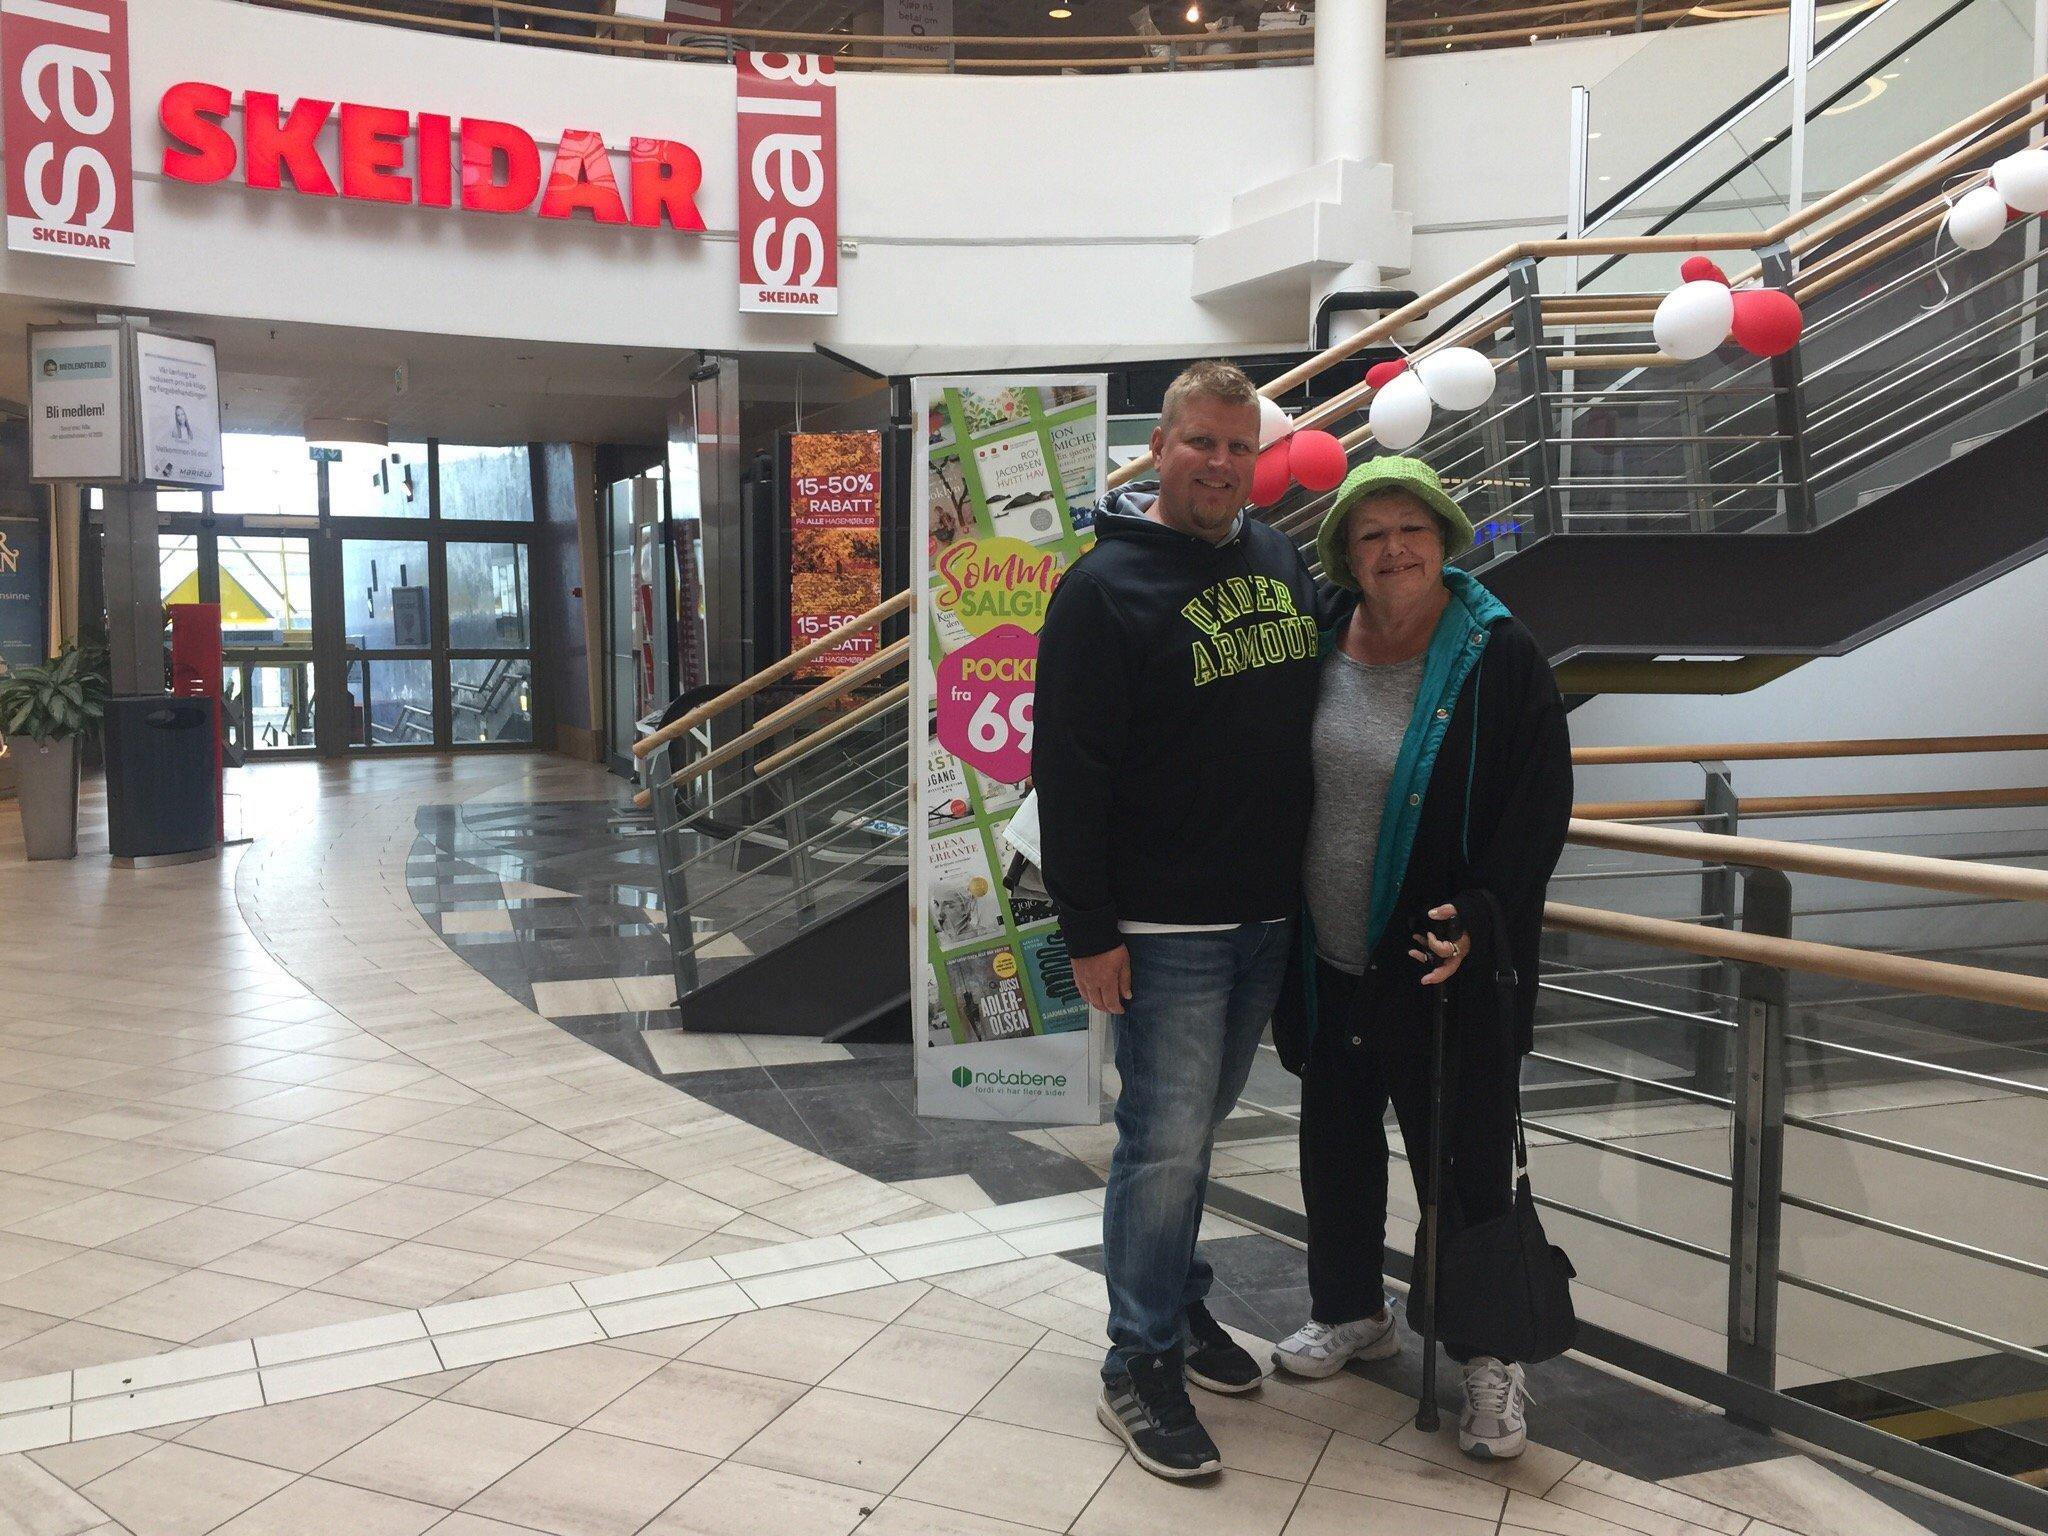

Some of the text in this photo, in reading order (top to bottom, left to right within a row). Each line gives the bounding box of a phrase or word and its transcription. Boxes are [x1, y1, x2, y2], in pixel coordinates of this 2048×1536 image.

[158, 82, 707, 233] SKEIDAR
[32, 227, 111, 250] SKEIDAR
[758, 291, 819, 305] SKEIDAR
[46, 403, 105, 419] Bli medlem!
[1051, 426, 1074, 444] JON
[1020, 448, 1040, 461] ROY
[995, 459, 1042, 481] JACOBSEN
[796, 473, 874, 496] 15-50%
[809, 499, 873, 513] RABATT
[806, 517, 824, 525] ALLE
[961, 590, 1042, 617] SALG!
[1180, 574, 1298, 636] UNDER
[1191, 615, 1319, 687] ARMOUR
[951, 685, 972, 701] fra
[980, 990, 1023, 1018] ADLER-
[989, 1008, 1030, 1037] OLSEN
[975, 1069, 1067, 1087] notabene
[975, 1086, 994, 1094] fordi
[1006, 1087, 1020, 1095] har
